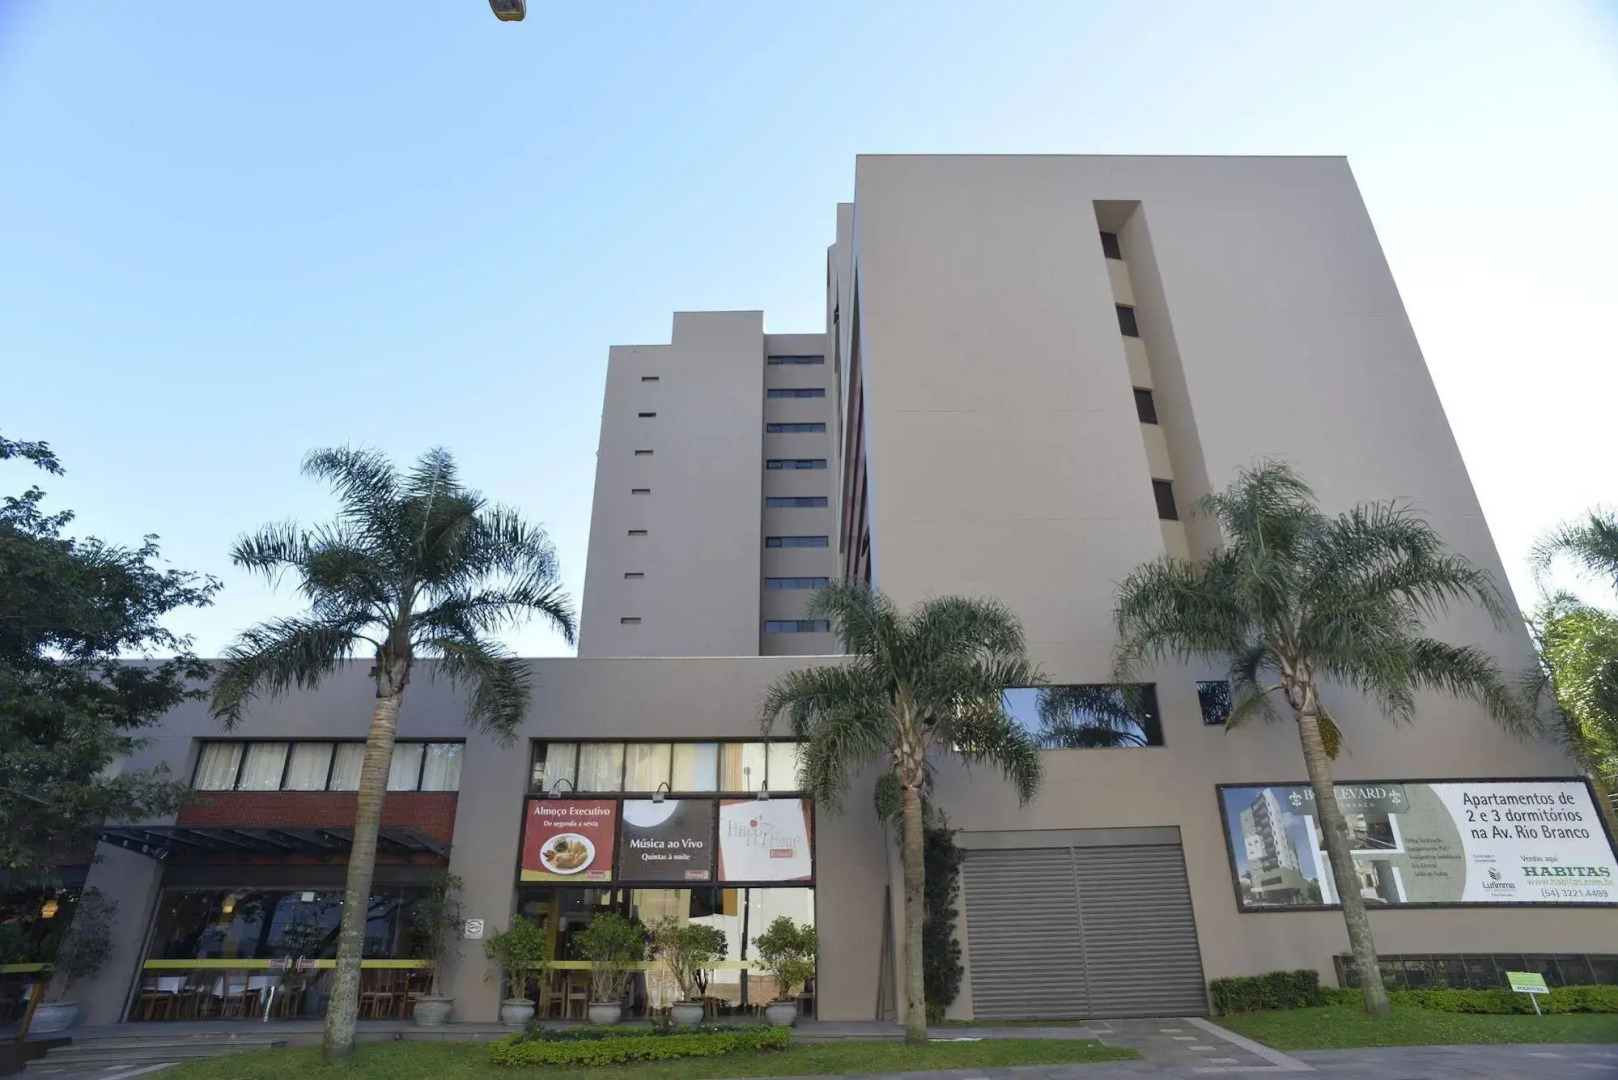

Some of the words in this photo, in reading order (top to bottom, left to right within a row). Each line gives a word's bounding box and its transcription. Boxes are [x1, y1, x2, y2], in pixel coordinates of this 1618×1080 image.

[1304, 788, 1386, 800] BLEVARD
[1463, 791, 1555, 809] Apartamentos
[1558, 791, 1575, 804] de
[533, 806, 567, 816] Almoço
[569, 806, 611, 816] Executivo
[1466, 809, 1476, 822] 2
[1480, 812, 1489, 822] e
[1491, 809, 1501, 822] 3
[1505, 807, 1583, 822] dormitórios
[553, 820, 577, 828] segunda
[1471, 828, 1488, 839] na
[1492, 825, 1512, 839] Av.
[1514, 824, 1538, 839] Rio
[1541, 824, 1590, 839] Branco
[629, 838, 665, 849] Música
[681, 838, 703, 848] Vivo
[641, 853, 667, 861] Quintas
[1521, 866, 1611, 877] HABITAS
[1541, 889, 1560, 898] (54)
